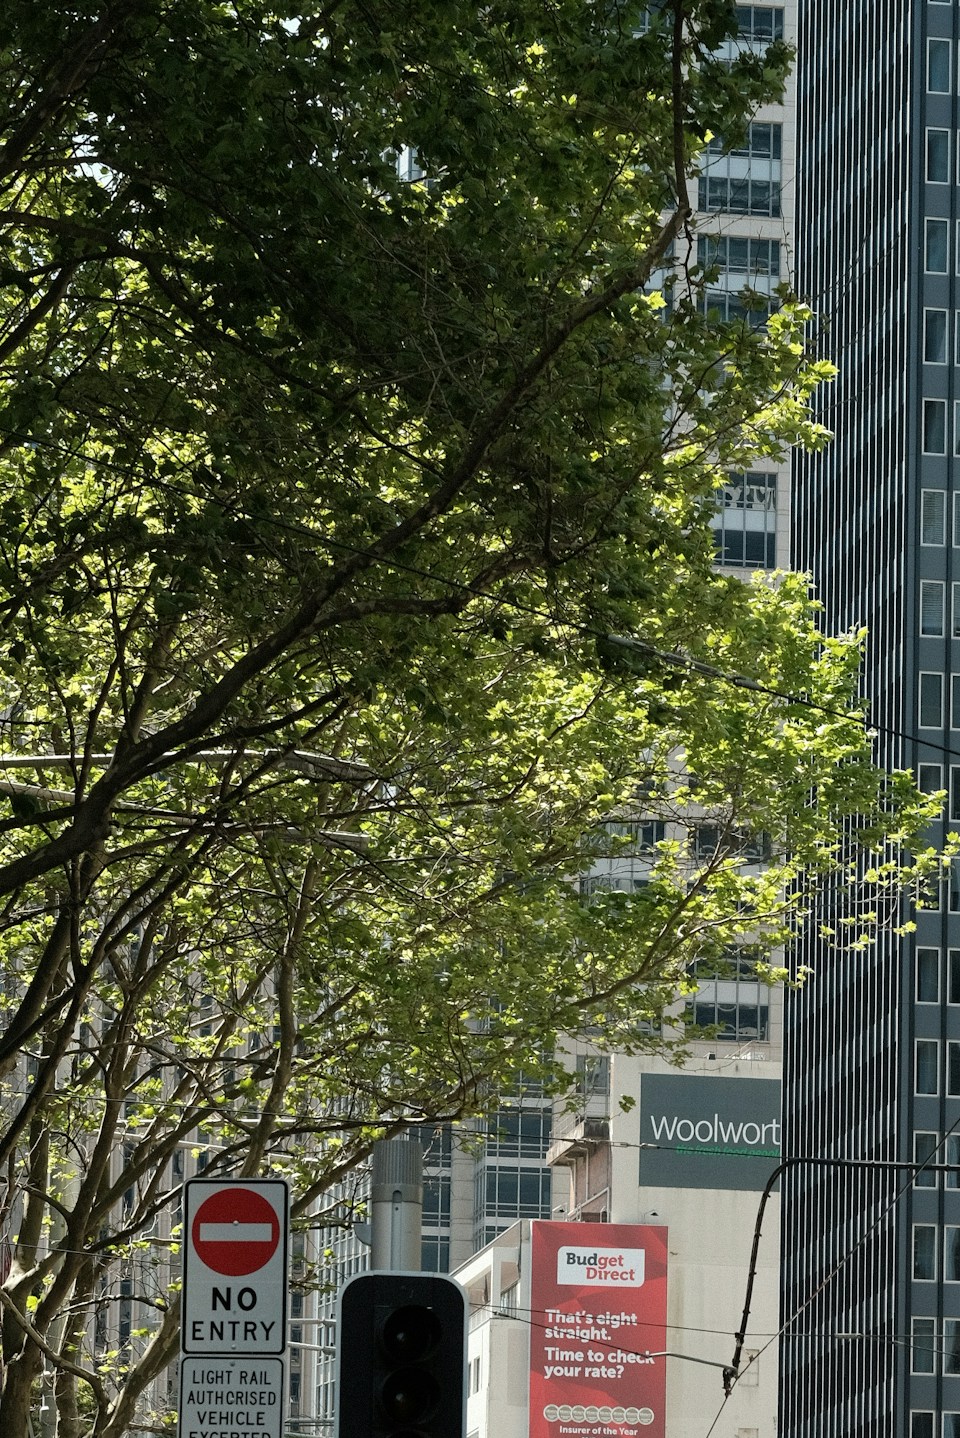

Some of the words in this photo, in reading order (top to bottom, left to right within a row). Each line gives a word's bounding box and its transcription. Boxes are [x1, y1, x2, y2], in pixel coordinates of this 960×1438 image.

[650, 1113, 781, 1145] Woolwort
[566, 1252, 624, 1269] Budget
[586, 1266, 635, 1281] Direct
[211, 1287, 257, 1311] NO
[545, 1309, 594, 1325] That's
[596, 1311, 638, 1329] eight
[192, 1321, 275, 1341] ENTRY
[545, 1325, 611, 1342] straight.
[544, 1347, 584, 1362] Time
[587, 1349, 604, 1362] to
[607, 1349, 655, 1365] check
[192, 1370, 233, 1385] LIGHT
[239, 1370, 271, 1385] RAIL
[544, 1366, 582, 1379] your
[584, 1365, 625, 1378] rate?
[187, 1391, 276, 1405] AUTHORISED
[197, 1411, 265, 1426] VEHICLE
[559, 1425, 591, 1434] Insurer
[592, 1426, 602, 1435] of
[603, 1427, 617, 1435] the
[619, 1428, 638, 1436] Year
